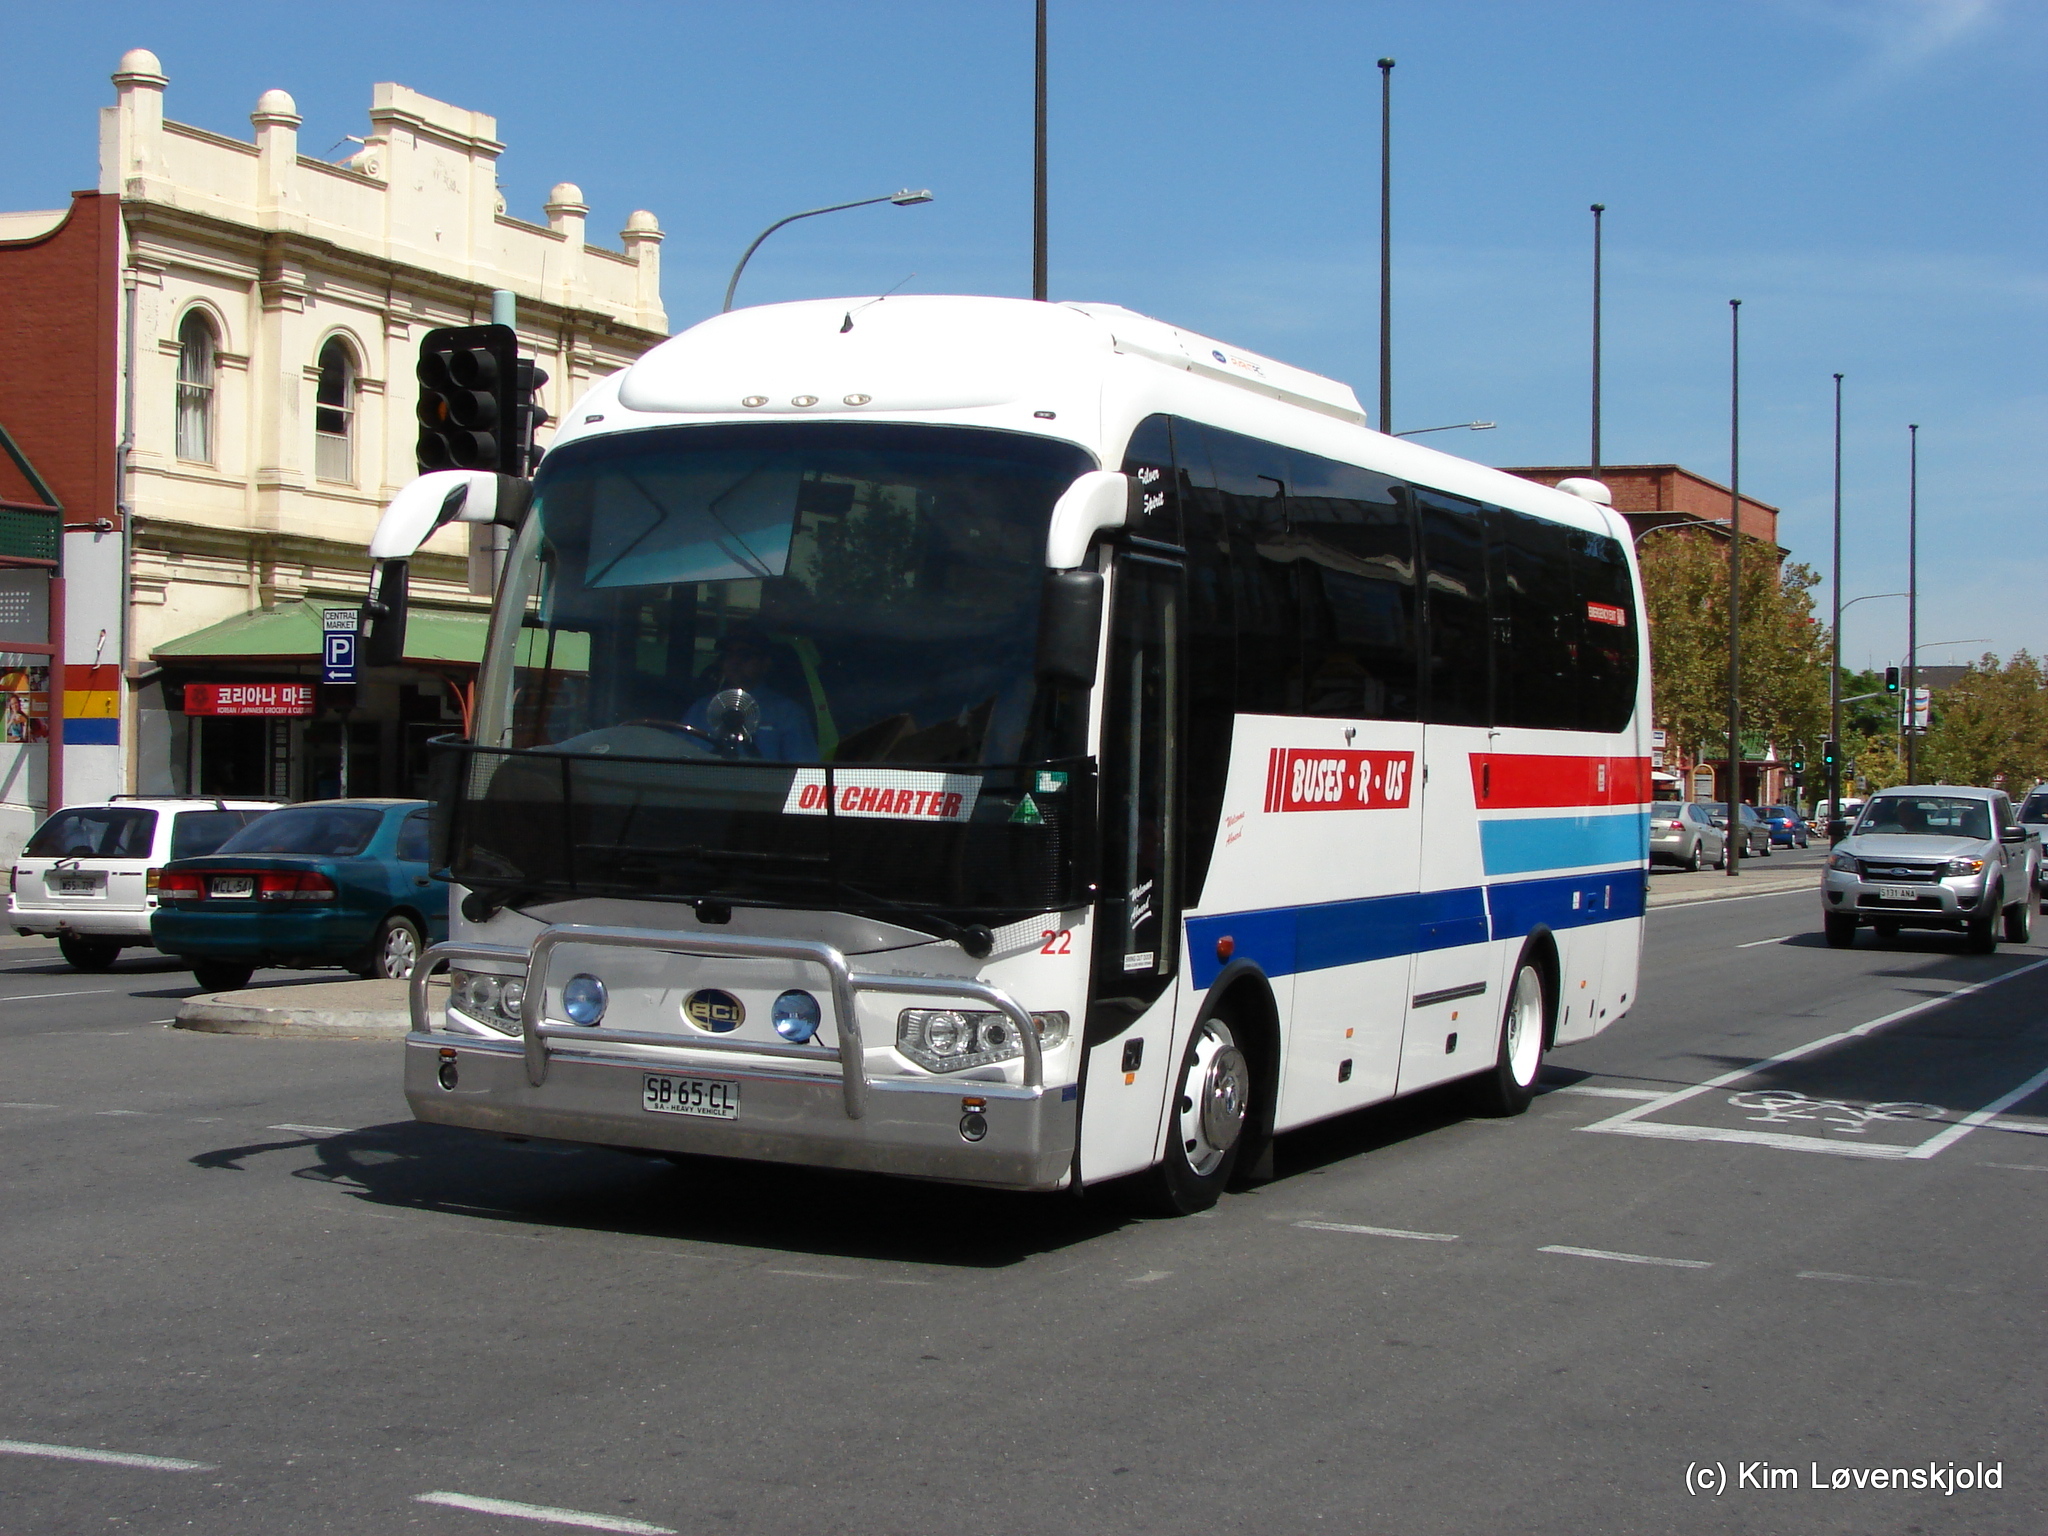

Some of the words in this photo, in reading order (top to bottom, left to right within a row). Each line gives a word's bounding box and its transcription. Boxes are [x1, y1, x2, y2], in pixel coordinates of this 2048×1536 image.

[325, 612, 356, 620] CENTRAL
[326, 621, 355, 629] MARKET
[332, 639, 350, 663] P
[217, 687, 276, 706] 코리아나
[282, 687, 312, 706] 마트
[840, 786, 963, 818] CHARTER
[1900, 889, 1915, 897] ANA
[1040, 930, 1071, 954] 22
[692, 1003, 738, 1020] BCI
[671, 1104, 694, 1113] HEAVY
[697, 1107, 727, 1117] VEHICLE
